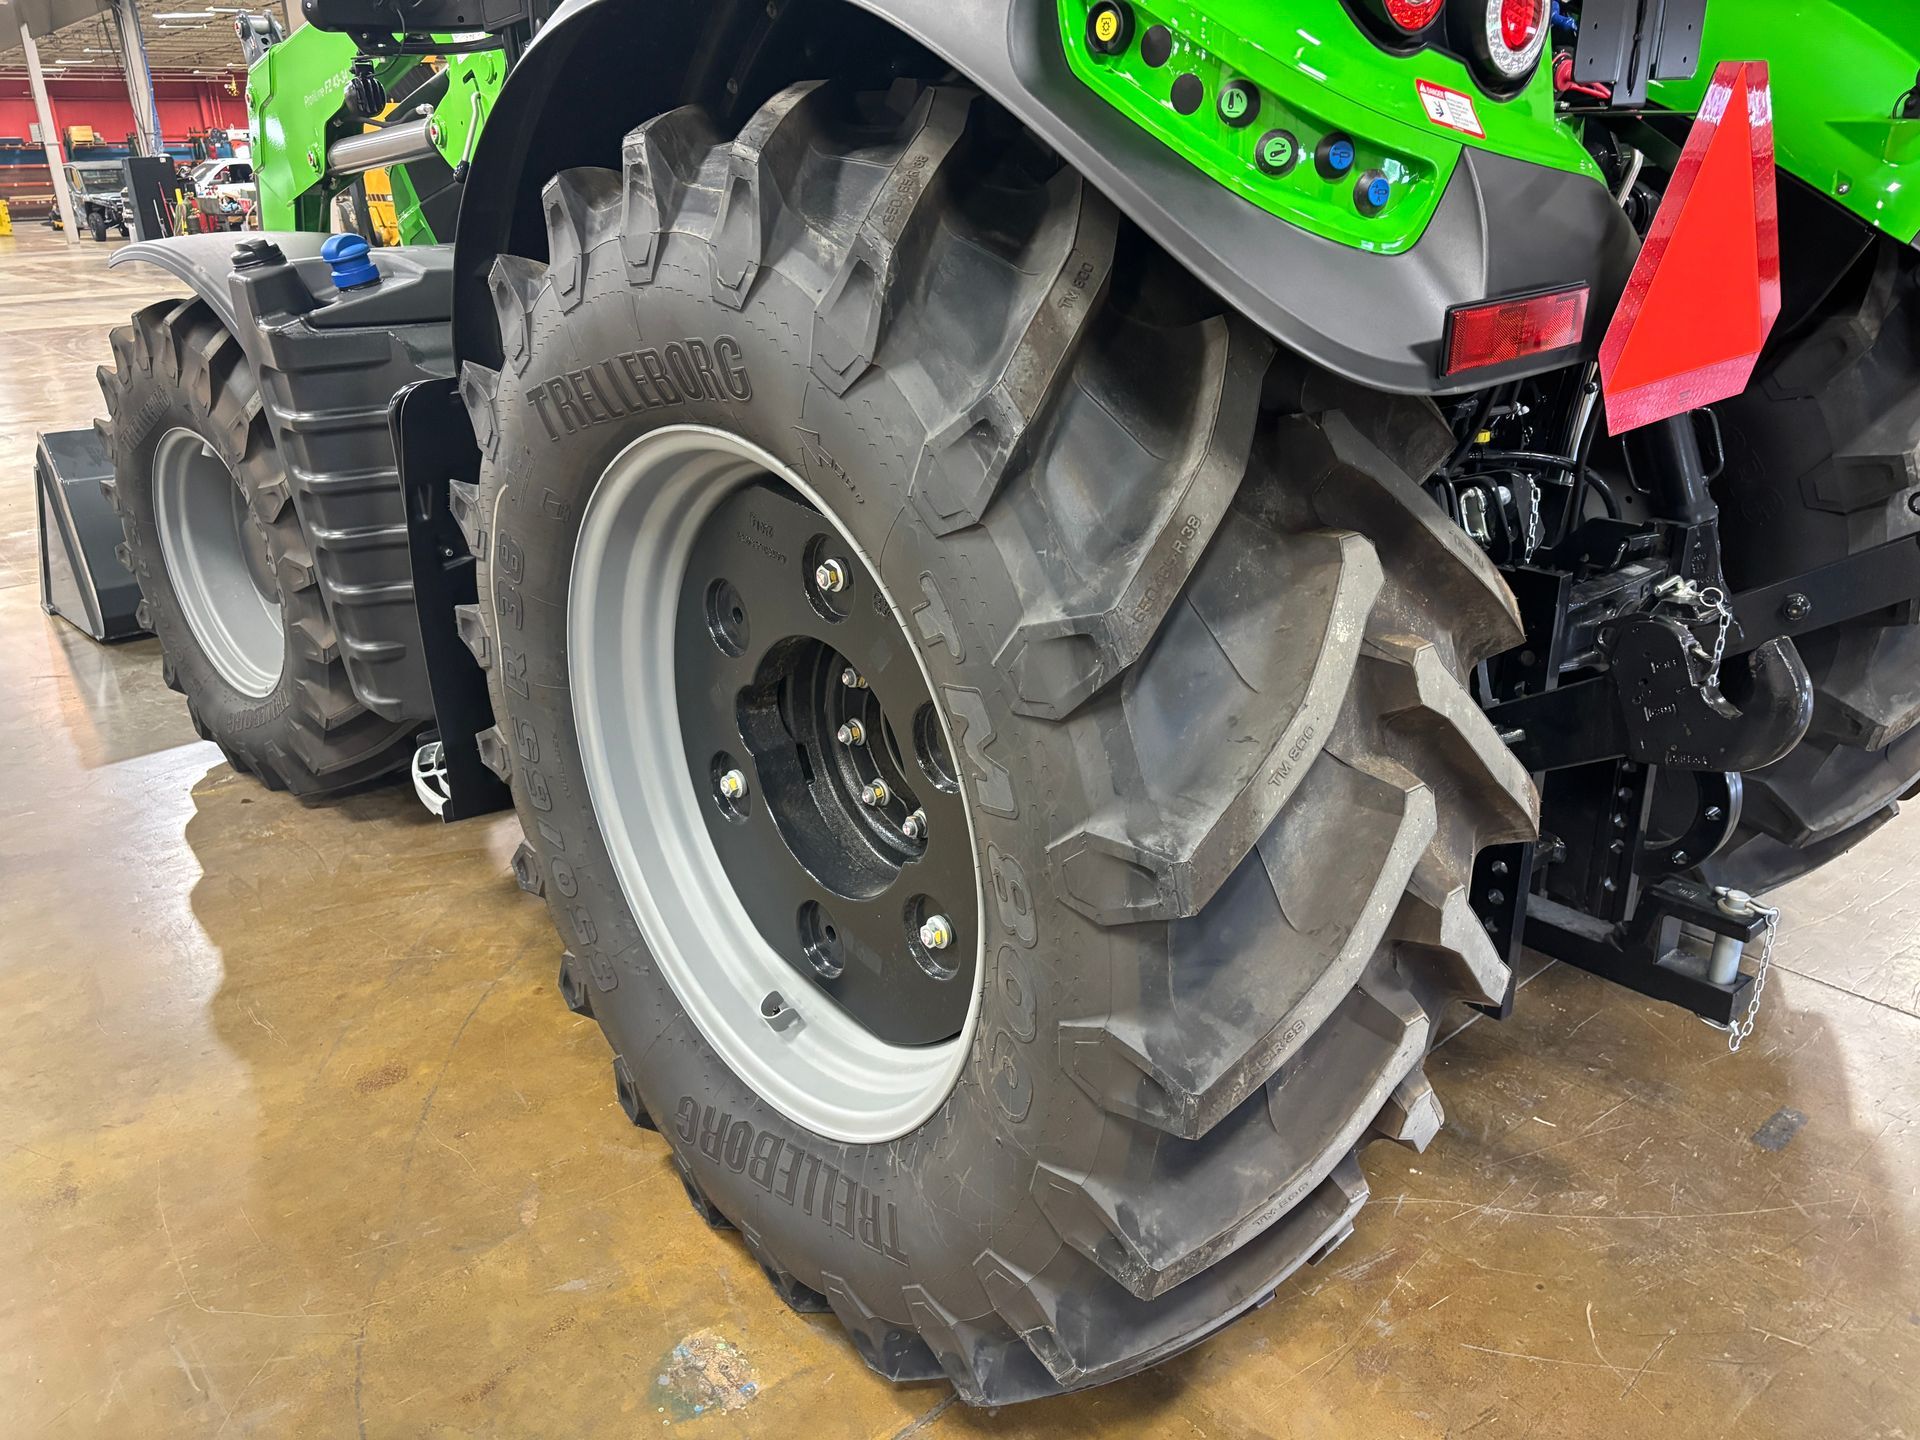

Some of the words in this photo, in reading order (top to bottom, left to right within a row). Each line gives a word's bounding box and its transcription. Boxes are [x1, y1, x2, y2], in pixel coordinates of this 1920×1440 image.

[526, 333, 753, 442] TRELLEBORG
[1180, 514, 1201, 540] 38
[1268, 762, 1293, 788] TM
[1288, 725, 1315, 762] 800
[910, 569, 1021, 821] TM
[986, 840, 1039, 1125] 800
[1283, 1020, 1306, 1042] 38
[674, 1095, 911, 1269] TRELLEBORG
